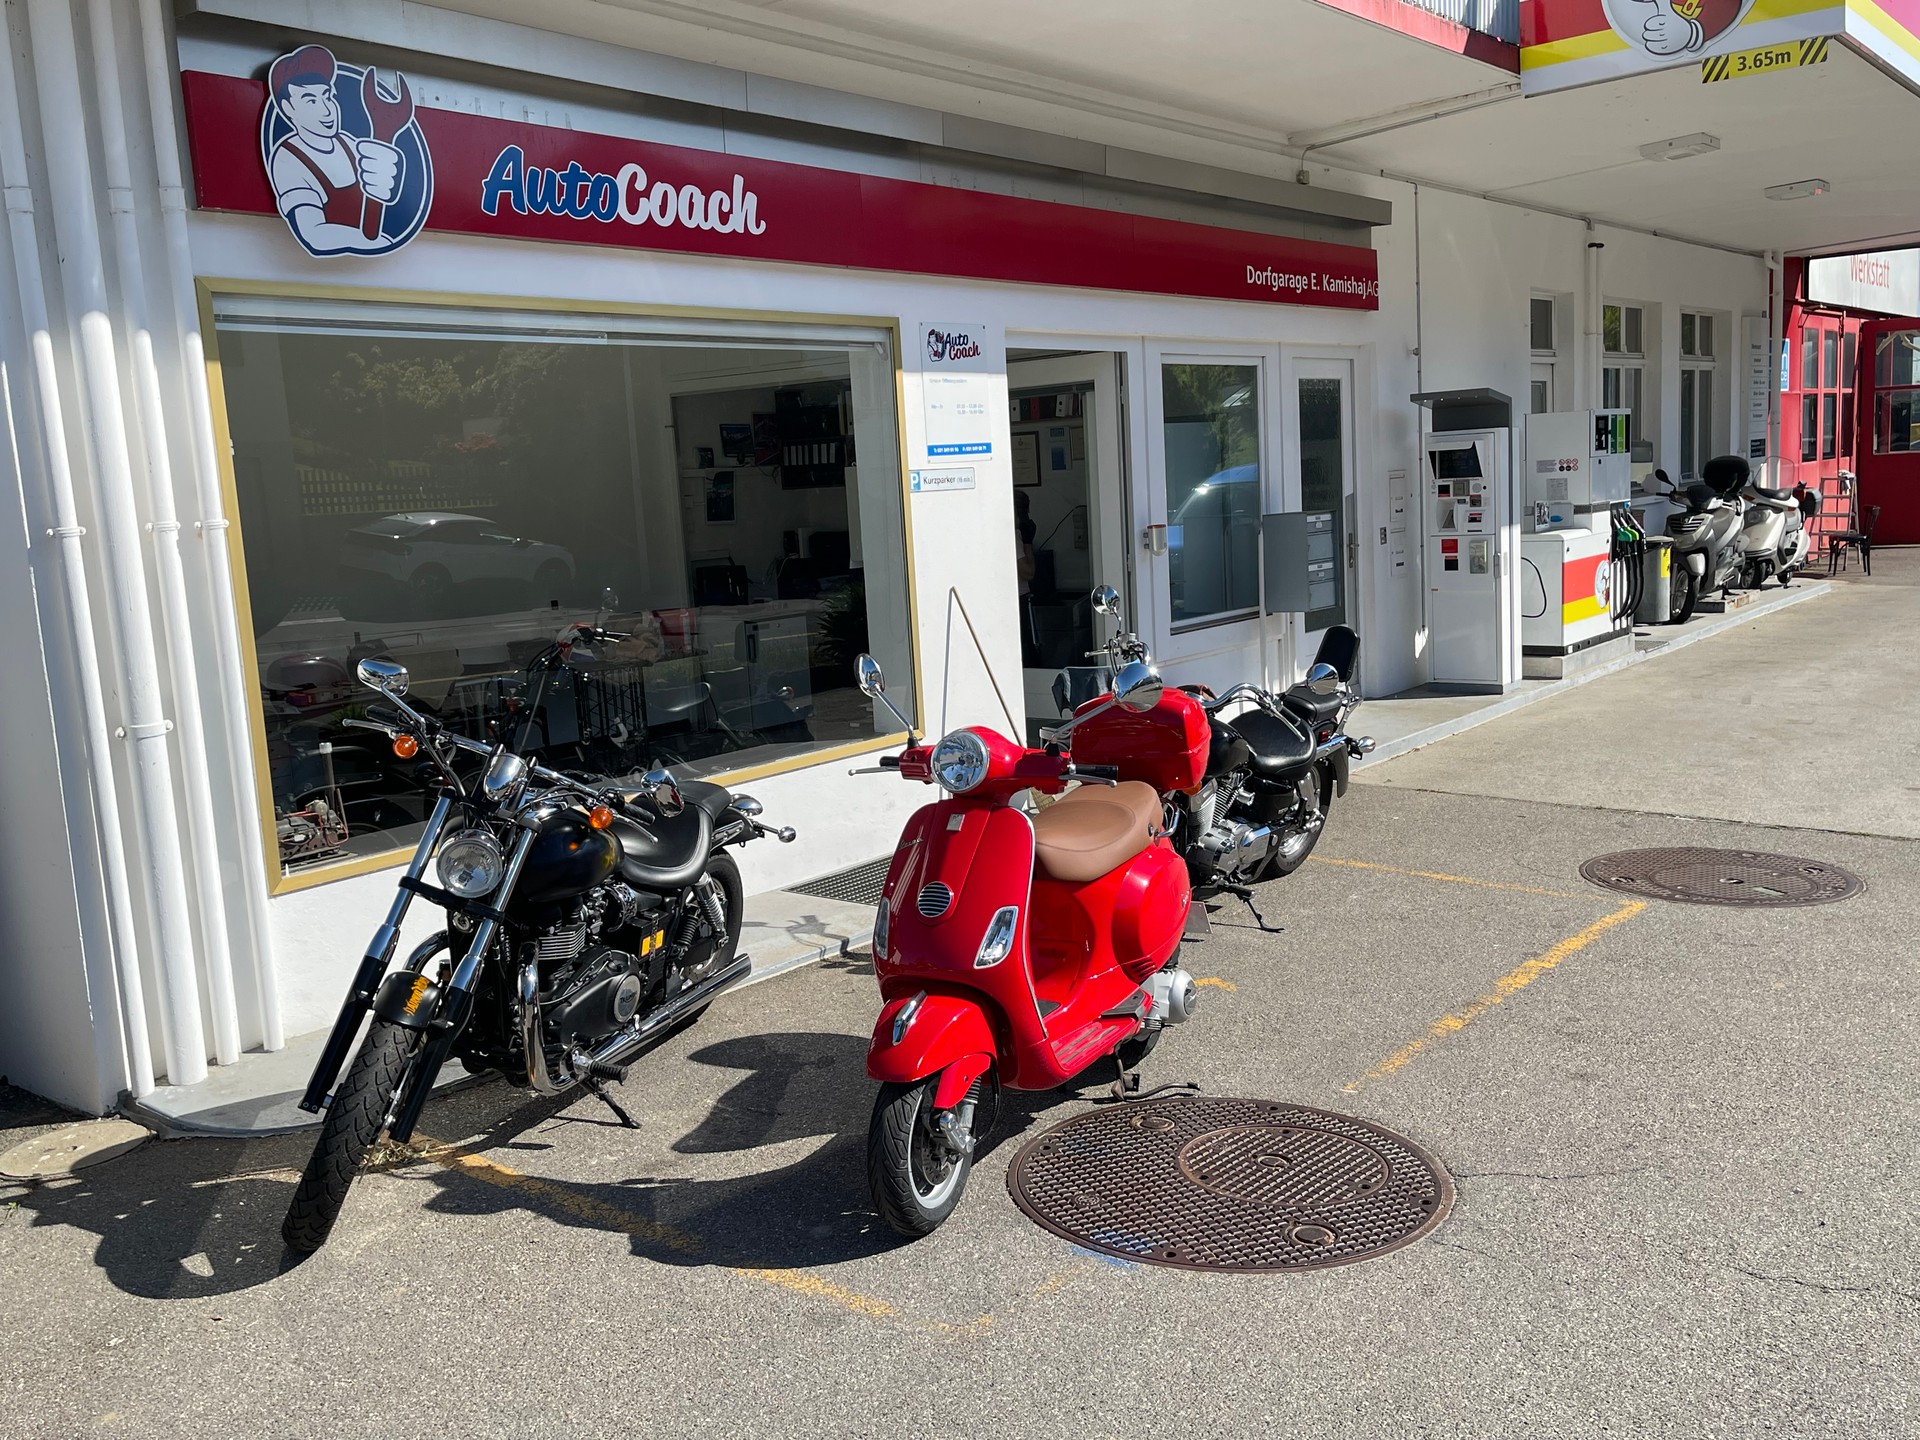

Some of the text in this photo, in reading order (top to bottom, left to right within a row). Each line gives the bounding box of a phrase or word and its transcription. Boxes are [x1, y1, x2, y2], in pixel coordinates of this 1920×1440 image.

[1737, 51, 1791, 71] 3.65m
[1246, 265, 1308, 293] Dorfgarage
[1311, 273, 1320, 290] E.
[1850, 254, 1890, 288] Werkstatt
[945, 333, 968, 349] Auto
[949, 341, 981, 360] Coach
[923, 476, 956, 485] Kurzparker
